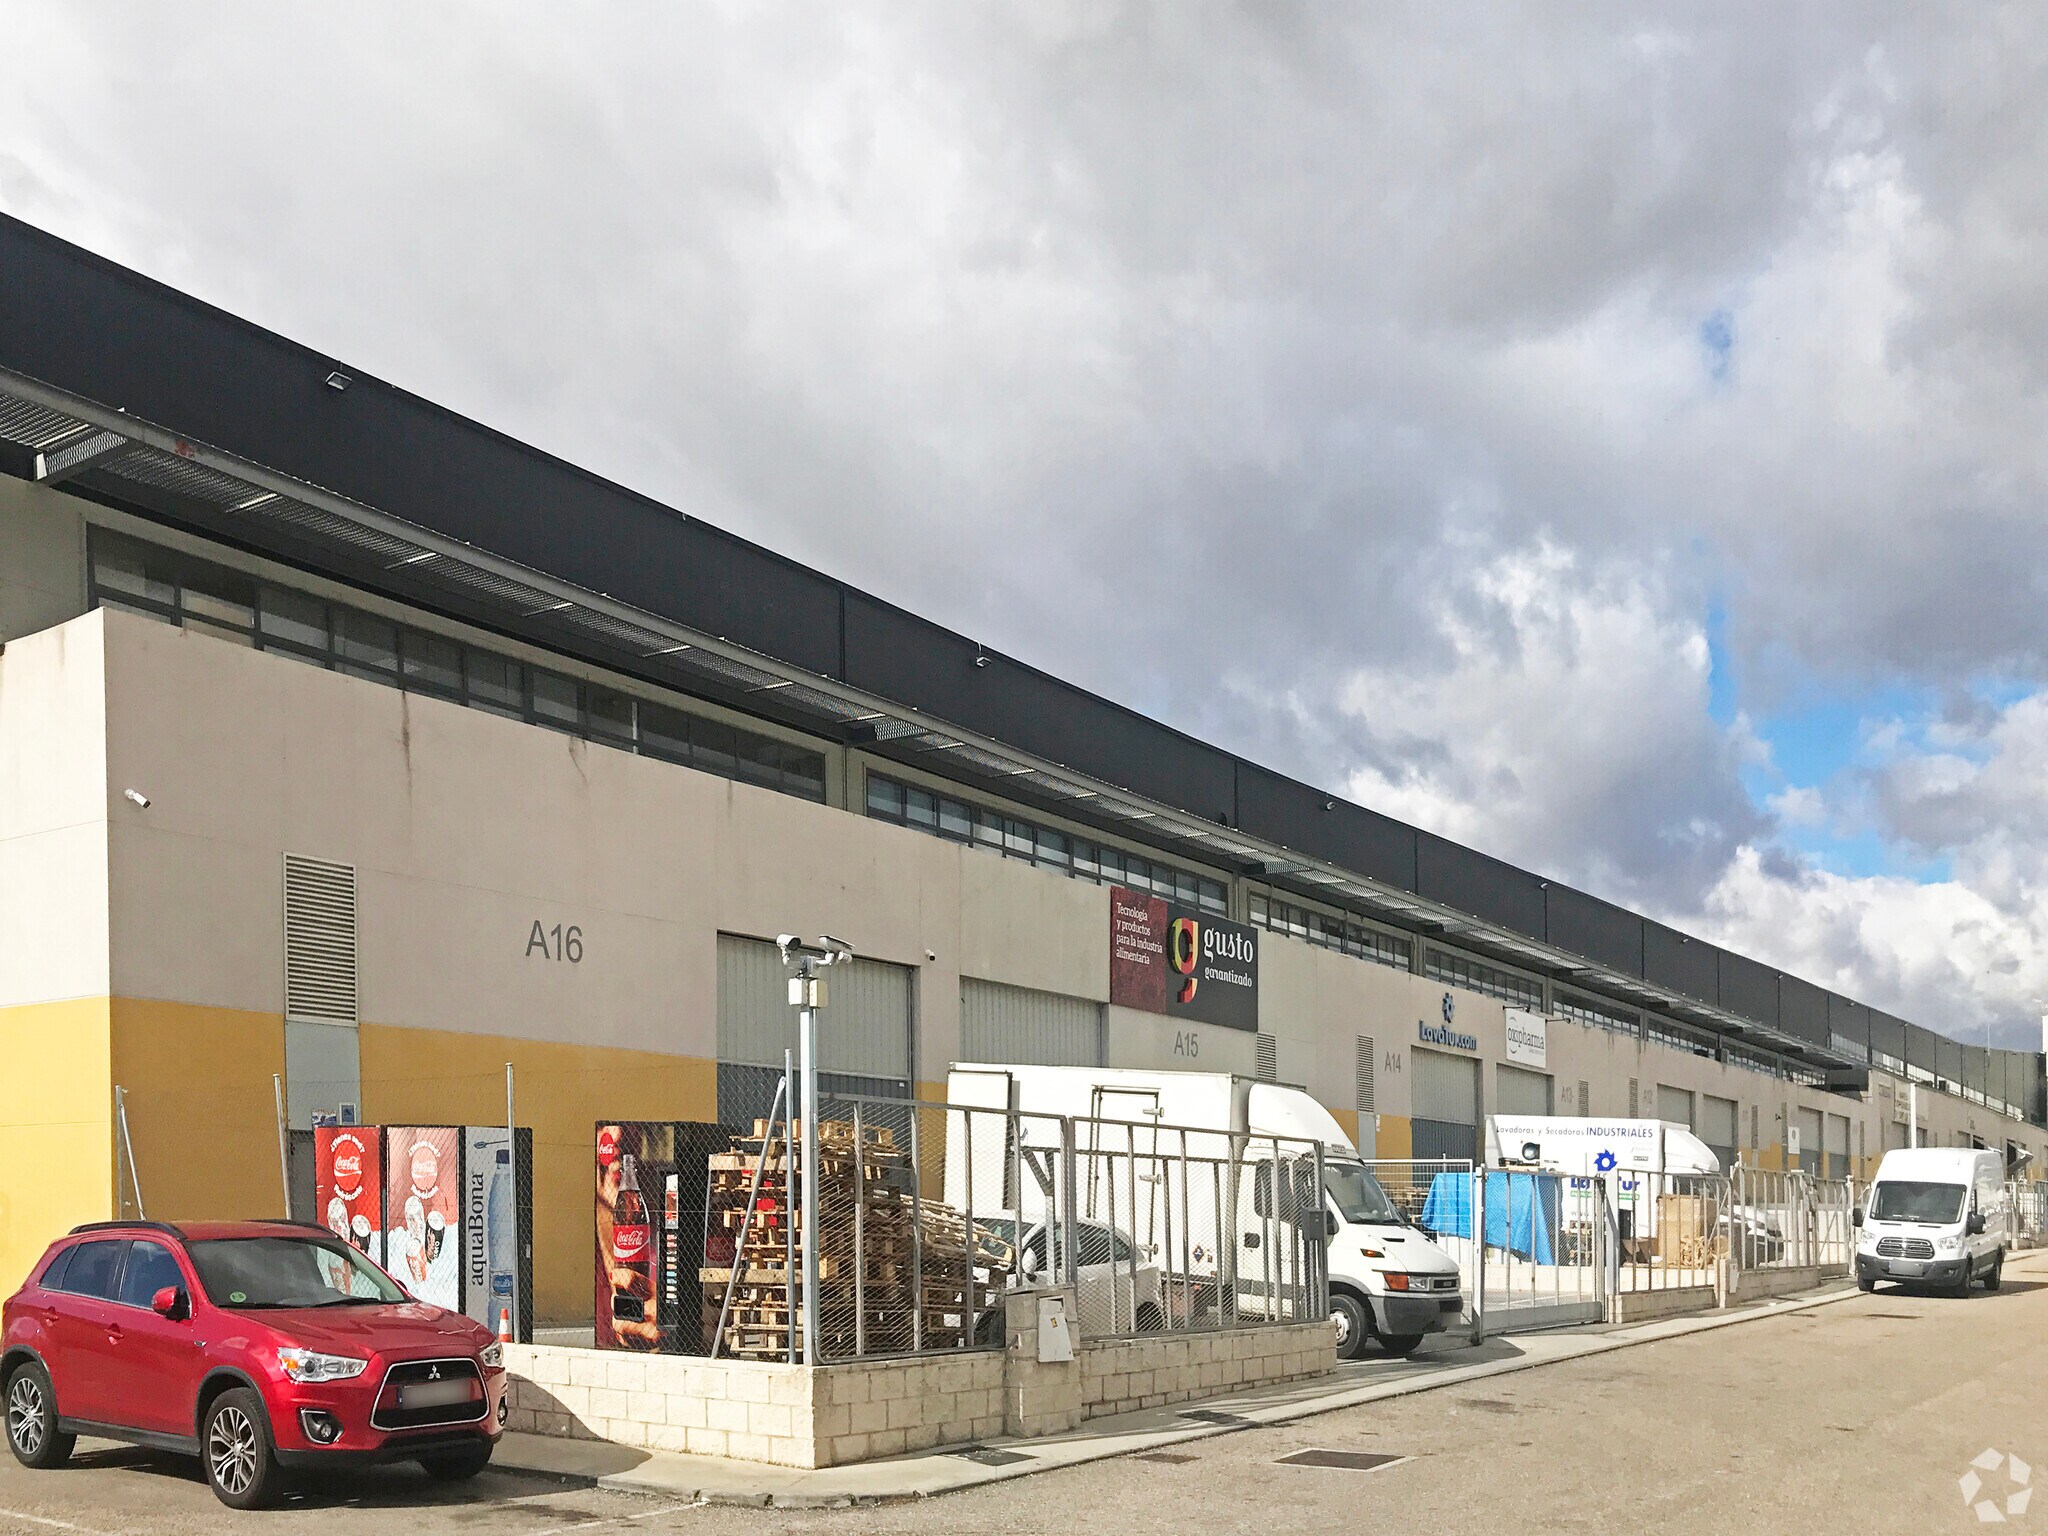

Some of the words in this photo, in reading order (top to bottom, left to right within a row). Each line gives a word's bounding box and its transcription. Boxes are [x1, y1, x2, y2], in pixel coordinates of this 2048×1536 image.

[1121, 920, 1151, 937] productos
[525, 919, 583, 964] A16
[1116, 933, 1130, 948] para
[1130, 934, 1136, 947] la
[1136, 936, 1163, 955] industria
[1203, 927, 1254, 964] gusto
[1115, 947, 1150, 965] alimentaria
[1204, 966, 1253, 988] garantizado
[1174, 1030, 1199, 1058] A15
[1419, 1018, 1477, 1051] LavaTur.com
[1507, 1025, 1545, 1050] oxipharma
[1384, 1051, 1402, 1074] A14
[1496, 1125, 1534, 1135] Lavadoras
[1545, 1126, 1585, 1136] Secadoras
[1586, 1126, 1653, 1139] INDUSTRIALES
[468, 1171, 487, 1287] aquaBona
[616, 1230, 643, 1246] Coca-Cola
